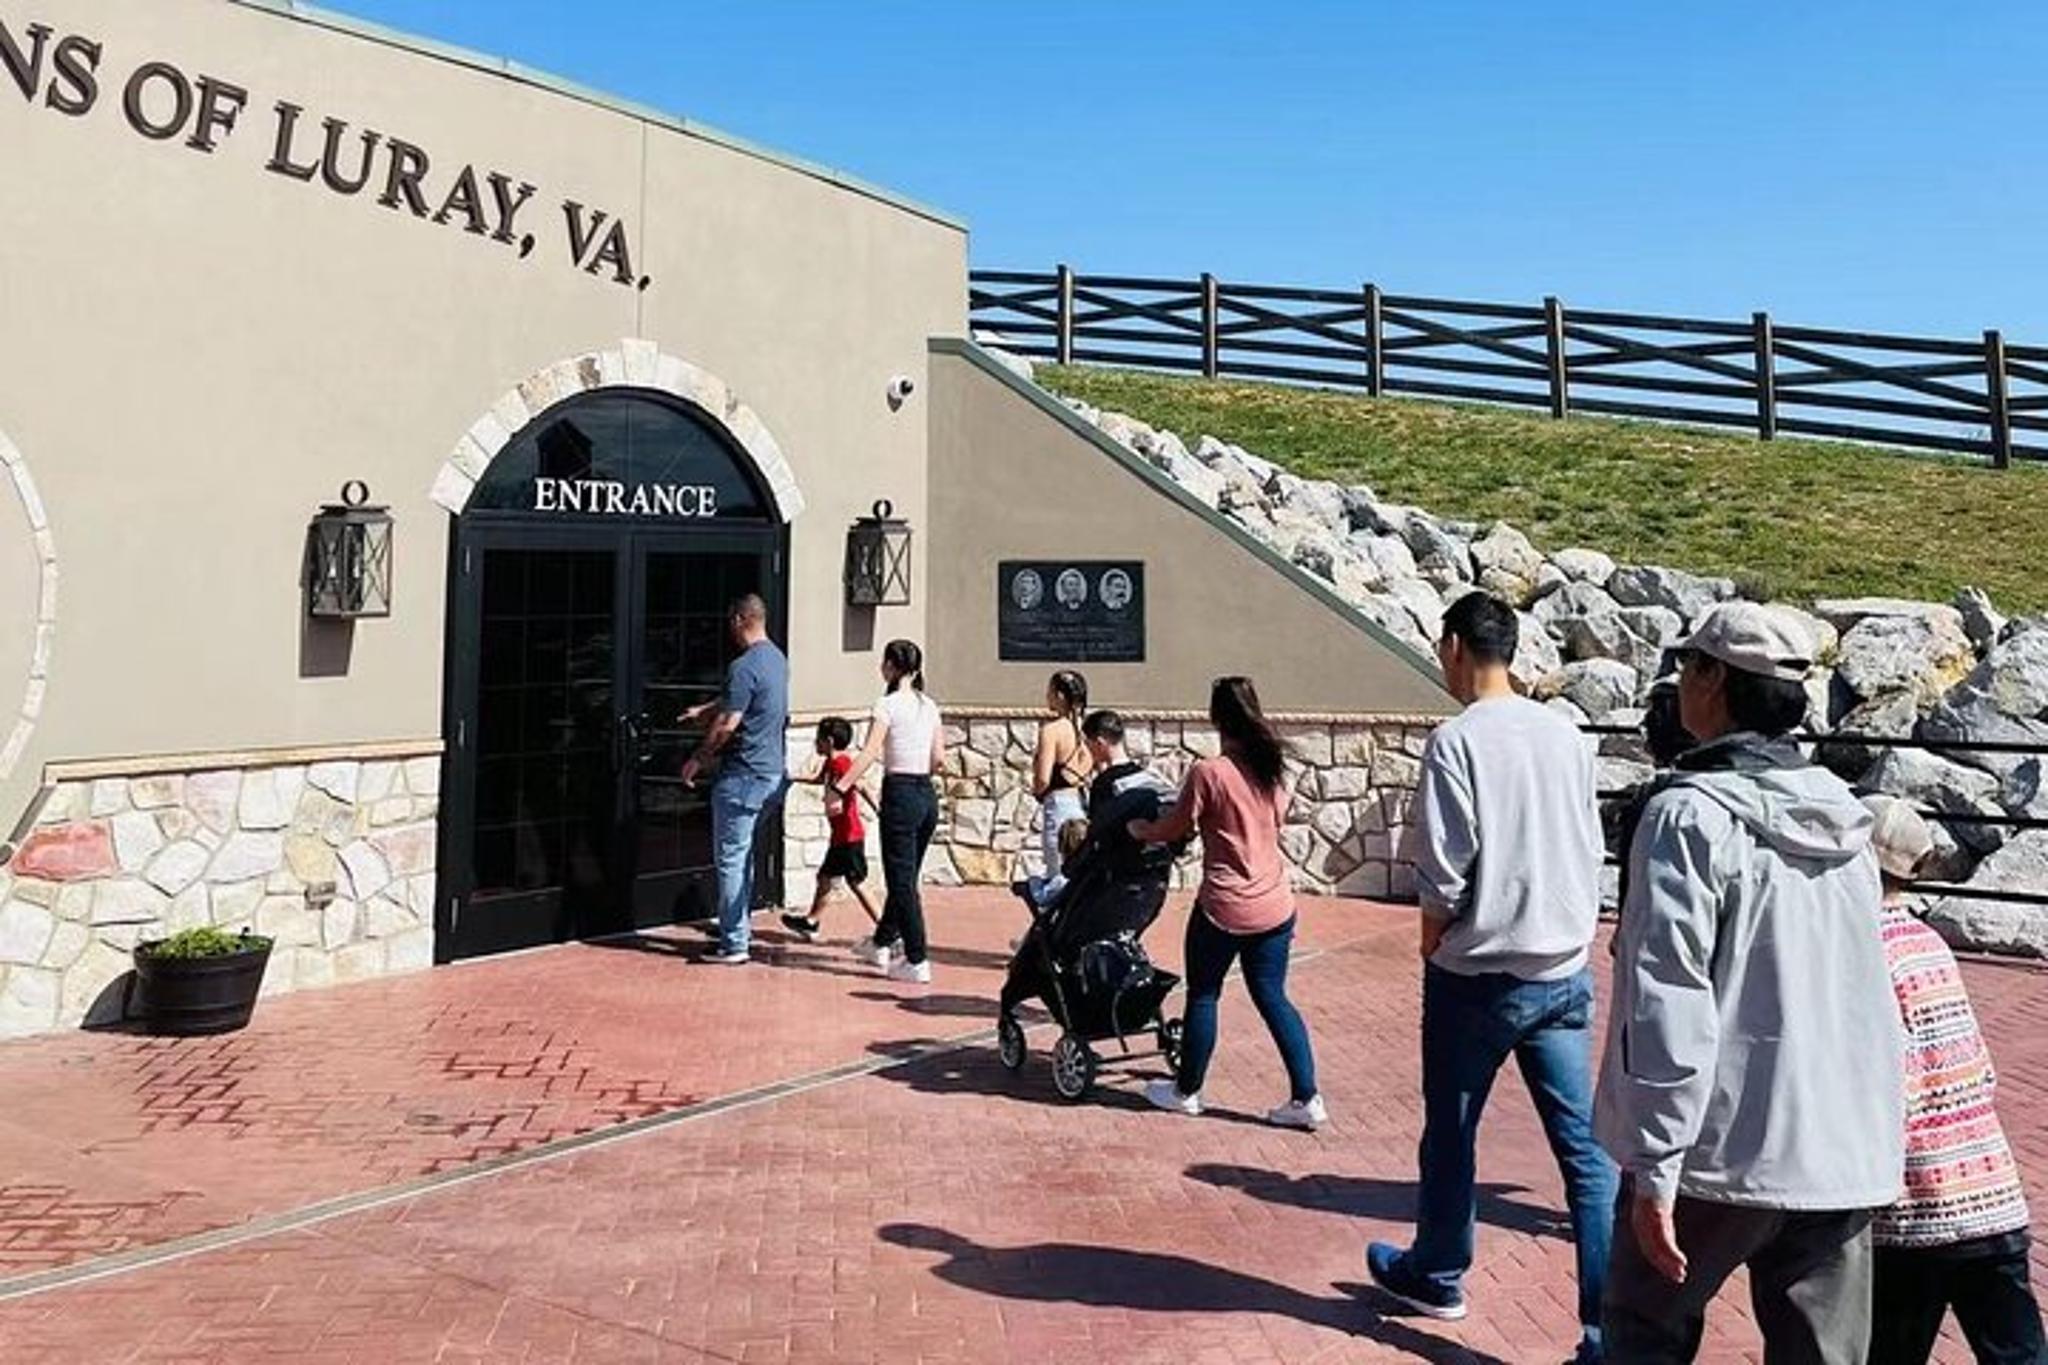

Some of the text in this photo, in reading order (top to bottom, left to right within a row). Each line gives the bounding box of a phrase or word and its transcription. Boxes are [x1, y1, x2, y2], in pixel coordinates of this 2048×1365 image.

[123, 61, 248, 153] OF
[265, 100, 537, 258] LURAY,
[535, 478, 717, 517] ENTRANCE
